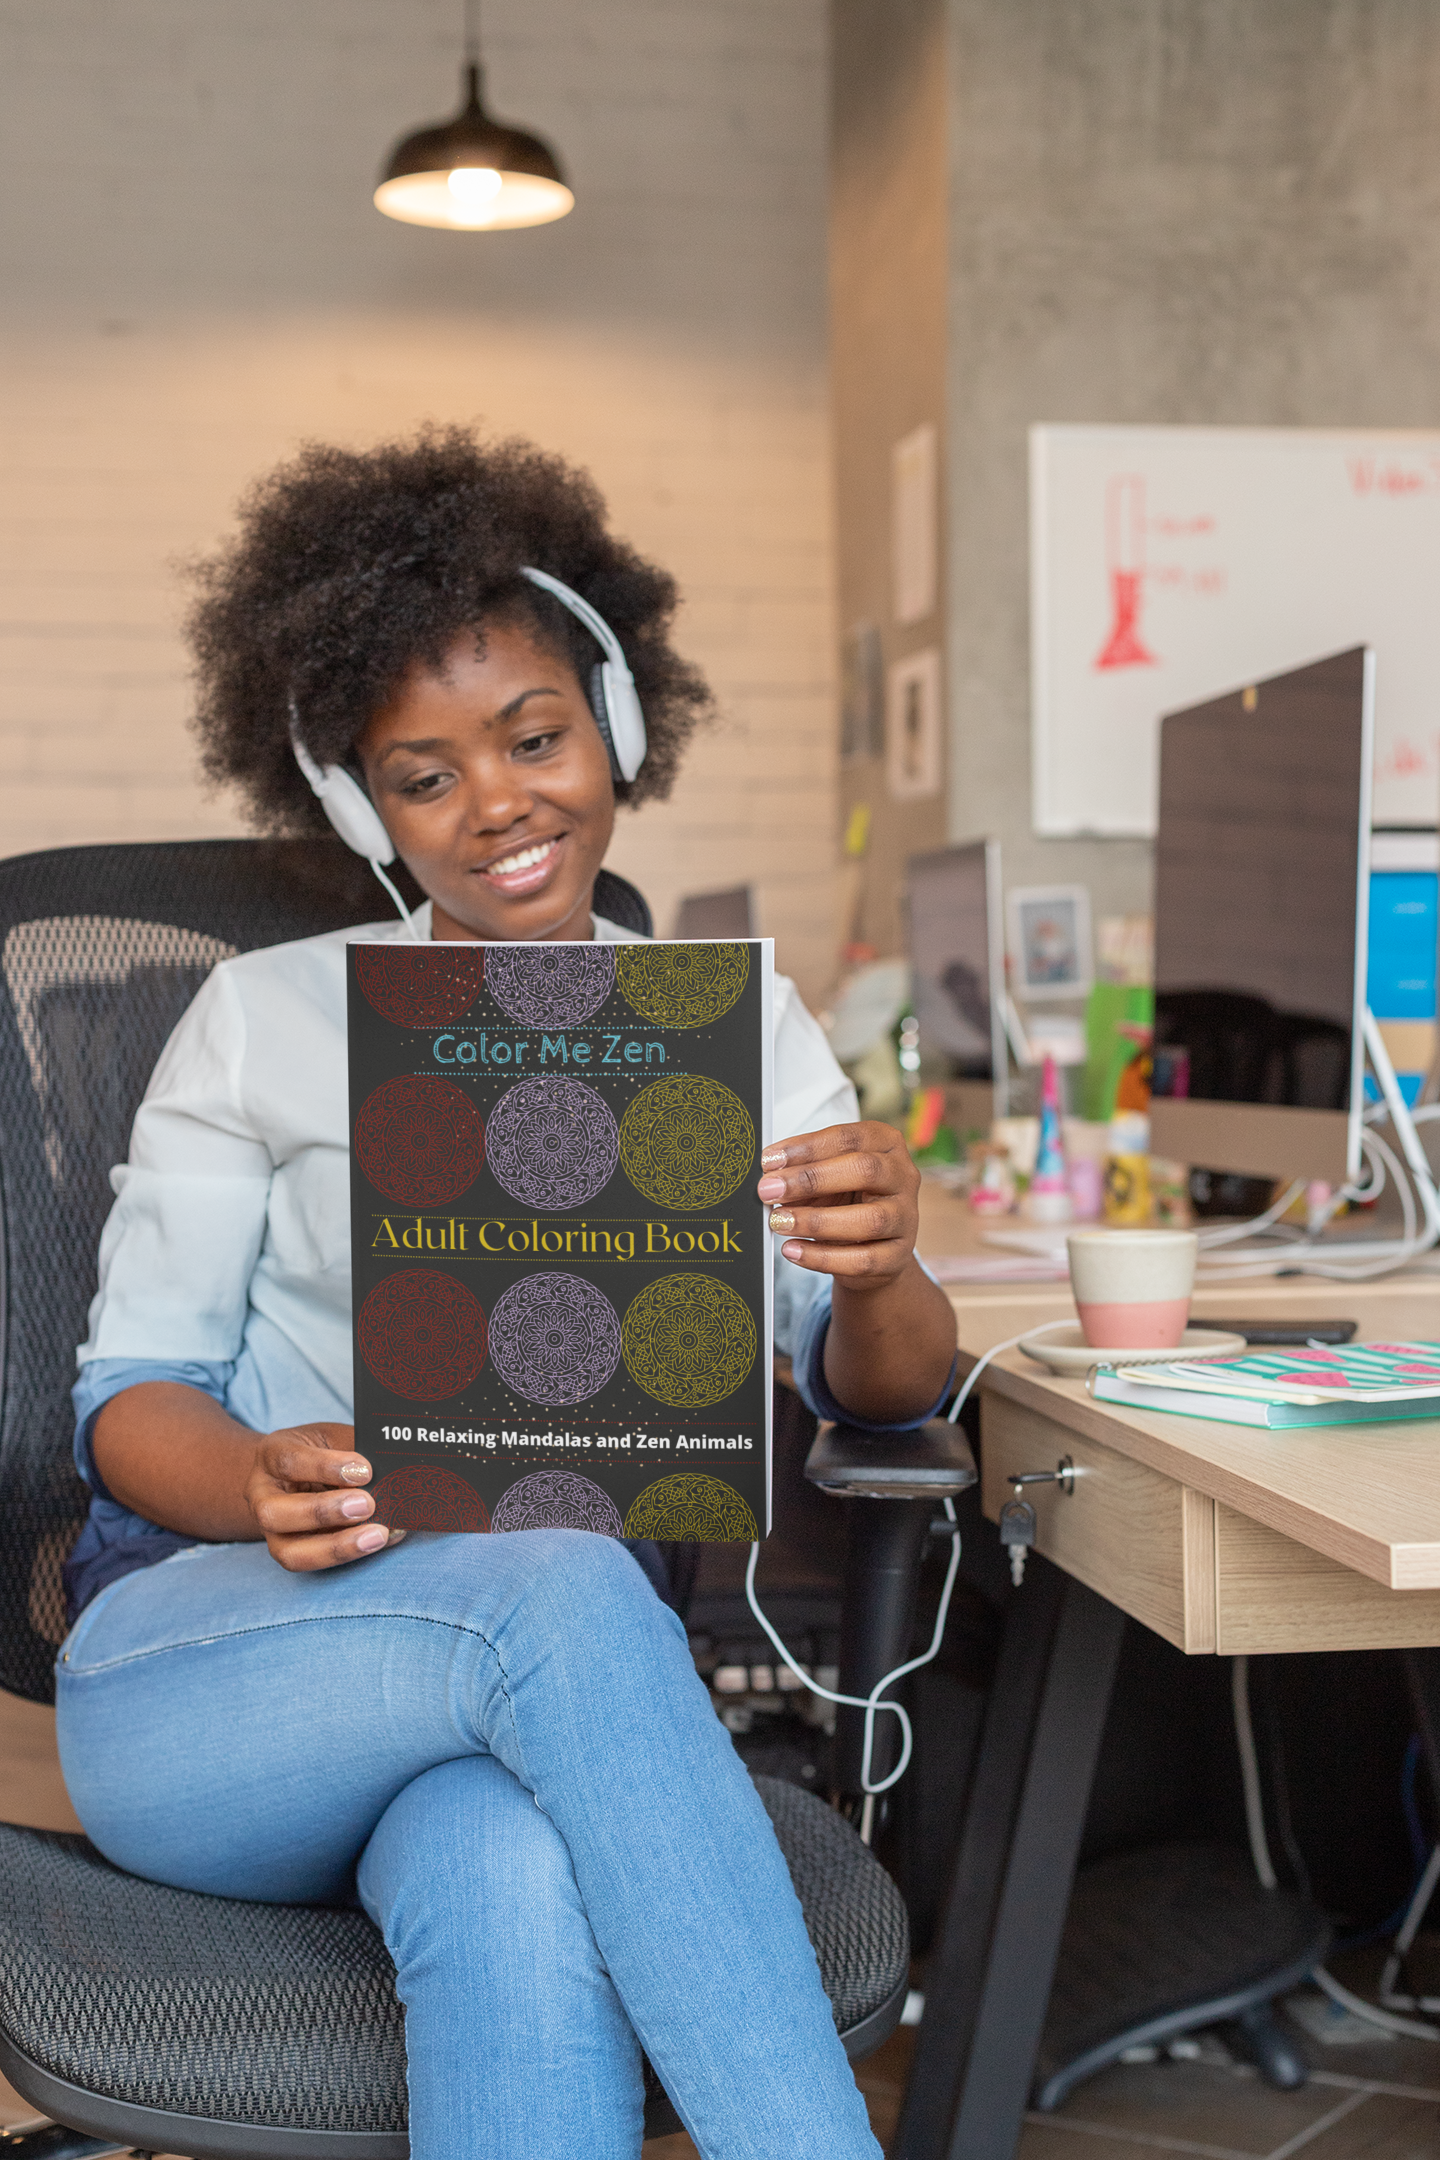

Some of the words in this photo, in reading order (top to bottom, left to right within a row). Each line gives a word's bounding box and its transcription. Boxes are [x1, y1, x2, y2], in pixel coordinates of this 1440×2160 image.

[433, 1032, 528, 1064] Color
[540, 1034, 591, 1064] Me
[601, 1034, 666, 1064] Zen
[371, 1217, 469, 1251] Adult
[478, 1219, 636, 1261] Coloring
[645, 1219, 744, 1253] Book
[381, 1426, 412, 1441] 100
[417, 1428, 497, 1449] Relaxing
[501, 1431, 591, 1448] Mandalas
[596, 1433, 631, 1448] and
[636, 1434, 671, 1449] Zen
[675, 1434, 753, 1450] Animals
